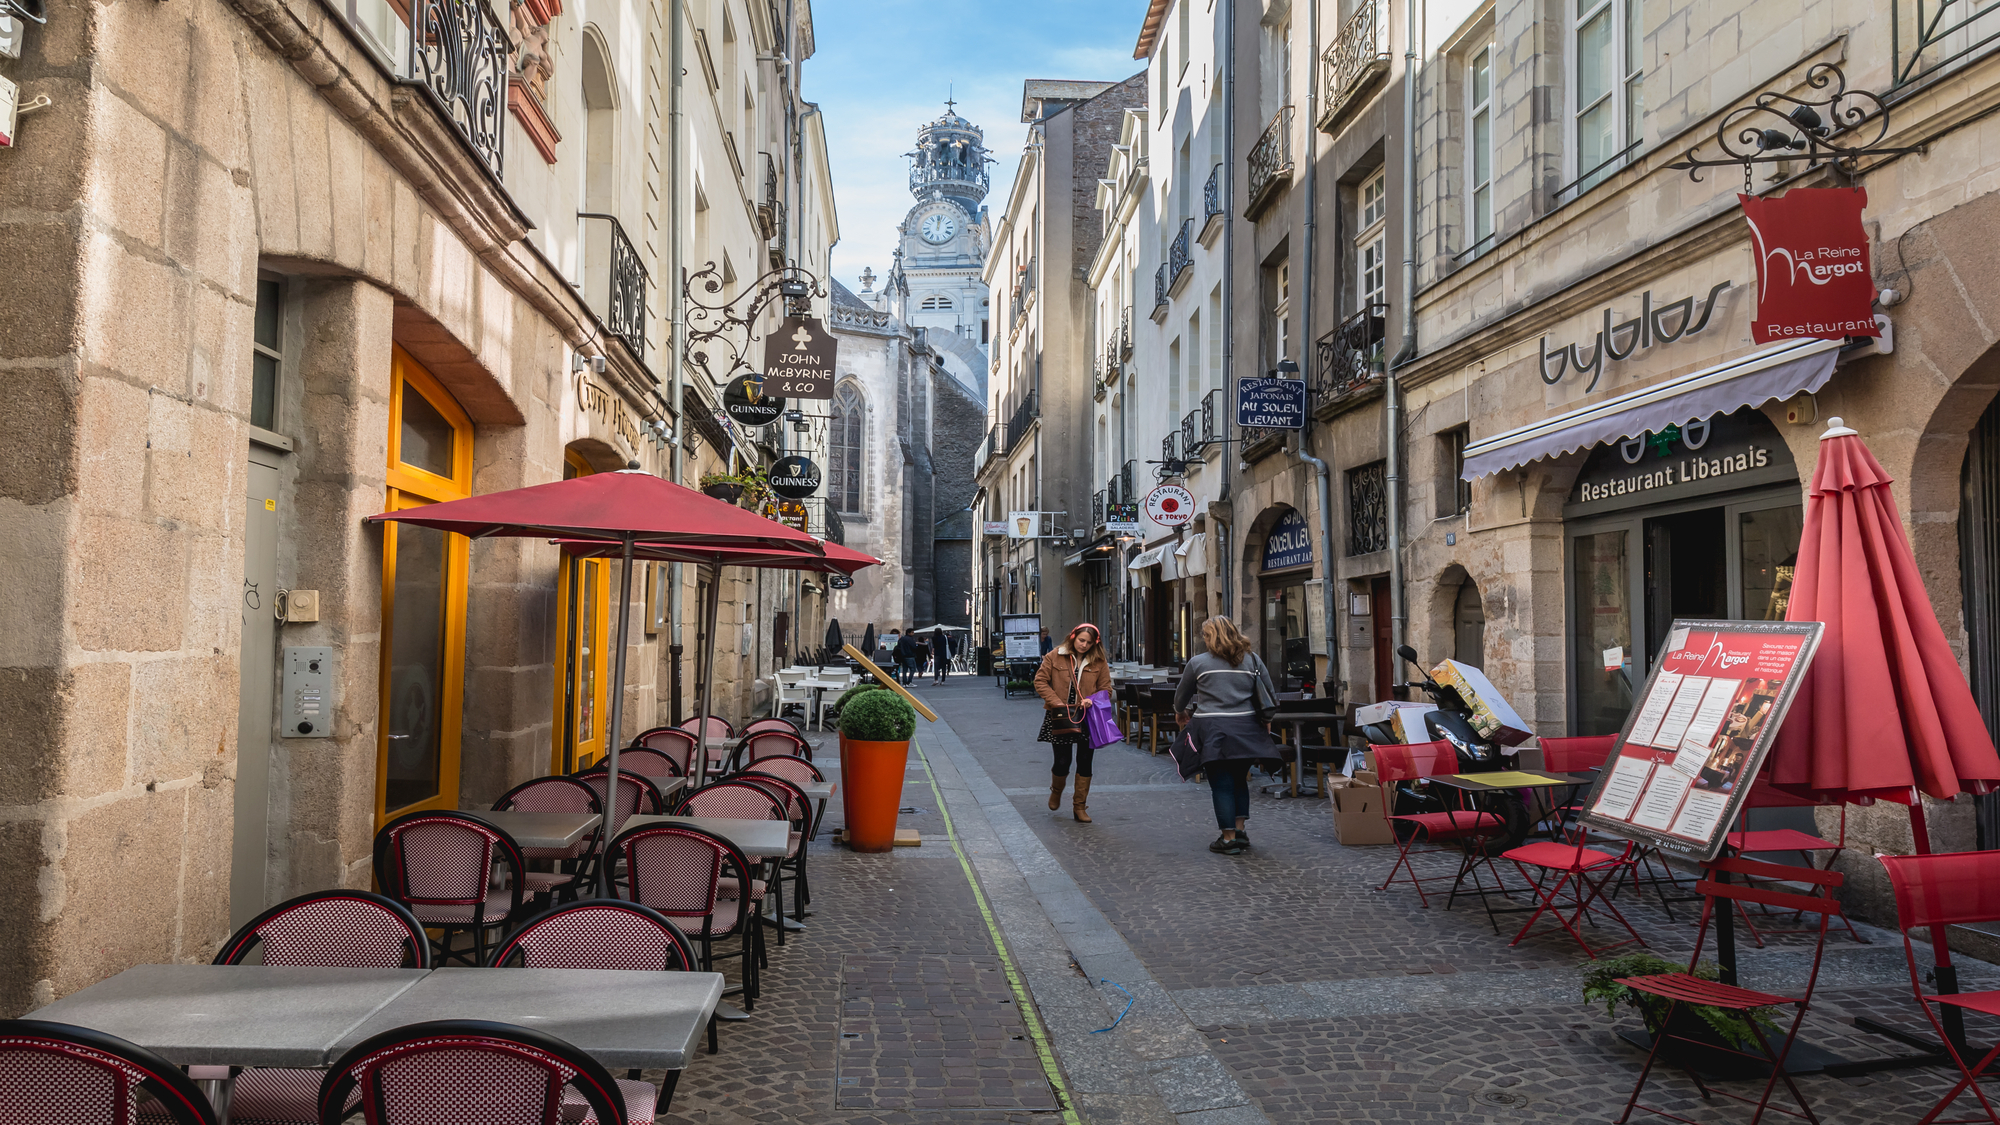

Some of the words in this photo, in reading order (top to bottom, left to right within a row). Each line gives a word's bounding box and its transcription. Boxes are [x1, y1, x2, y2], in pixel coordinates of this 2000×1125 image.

[1794, 249, 1815, 261] La
[1817, 246, 1861, 259] Reine
[1767, 317, 1875, 337] Restaurant
[1539, 279, 1732, 394] byblos
[779, 353, 820, 365] JOHN
[767, 366, 832, 380] McBYRNE
[782, 381, 792, 392] &
[795, 382, 815, 393] CO
[1241, 379, 1303, 395] RESTAURANT
[1250, 392, 1294, 401] JAPONAIS
[730, 404, 777, 415] GUINNESS
[1241, 401, 1258, 412] AU
[1262, 402, 1302, 414] SOLEIL
[1247, 415, 1293, 426] LEVANT
[1580, 466, 1674, 502] Restaurant
[1681, 445, 1768, 482] Libanais
[771, 475, 818, 487] GUINNESS
[1149, 487, 1191, 507] RESTAURANT
[1267, 553, 1301, 569] RESTAURANT
[1672, 651, 1683, 660] La
[1682, 651, 1705, 661] Reine
